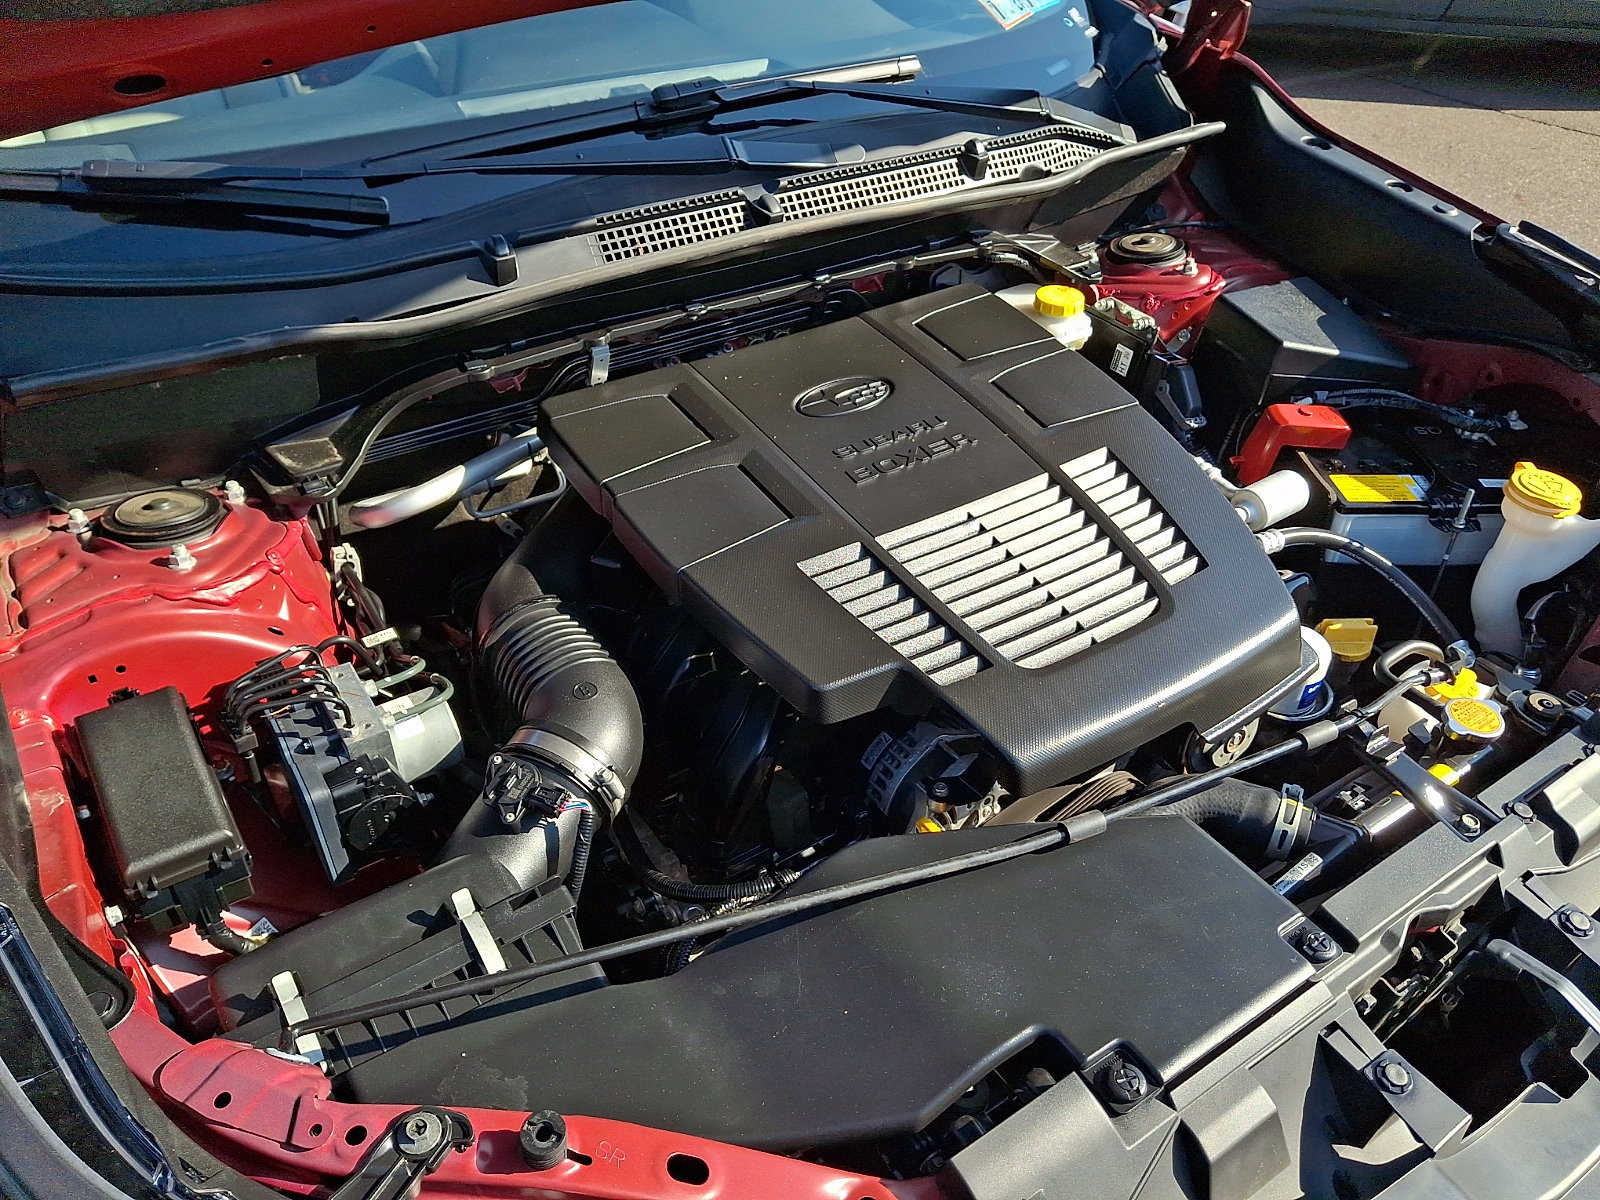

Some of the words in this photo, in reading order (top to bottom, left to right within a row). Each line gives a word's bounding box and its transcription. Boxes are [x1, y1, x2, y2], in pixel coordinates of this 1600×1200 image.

[831, 415, 948, 459] SUBARU
[844, 432, 979, 485] BOXER
[595, 1140, 626, 1169] SR
